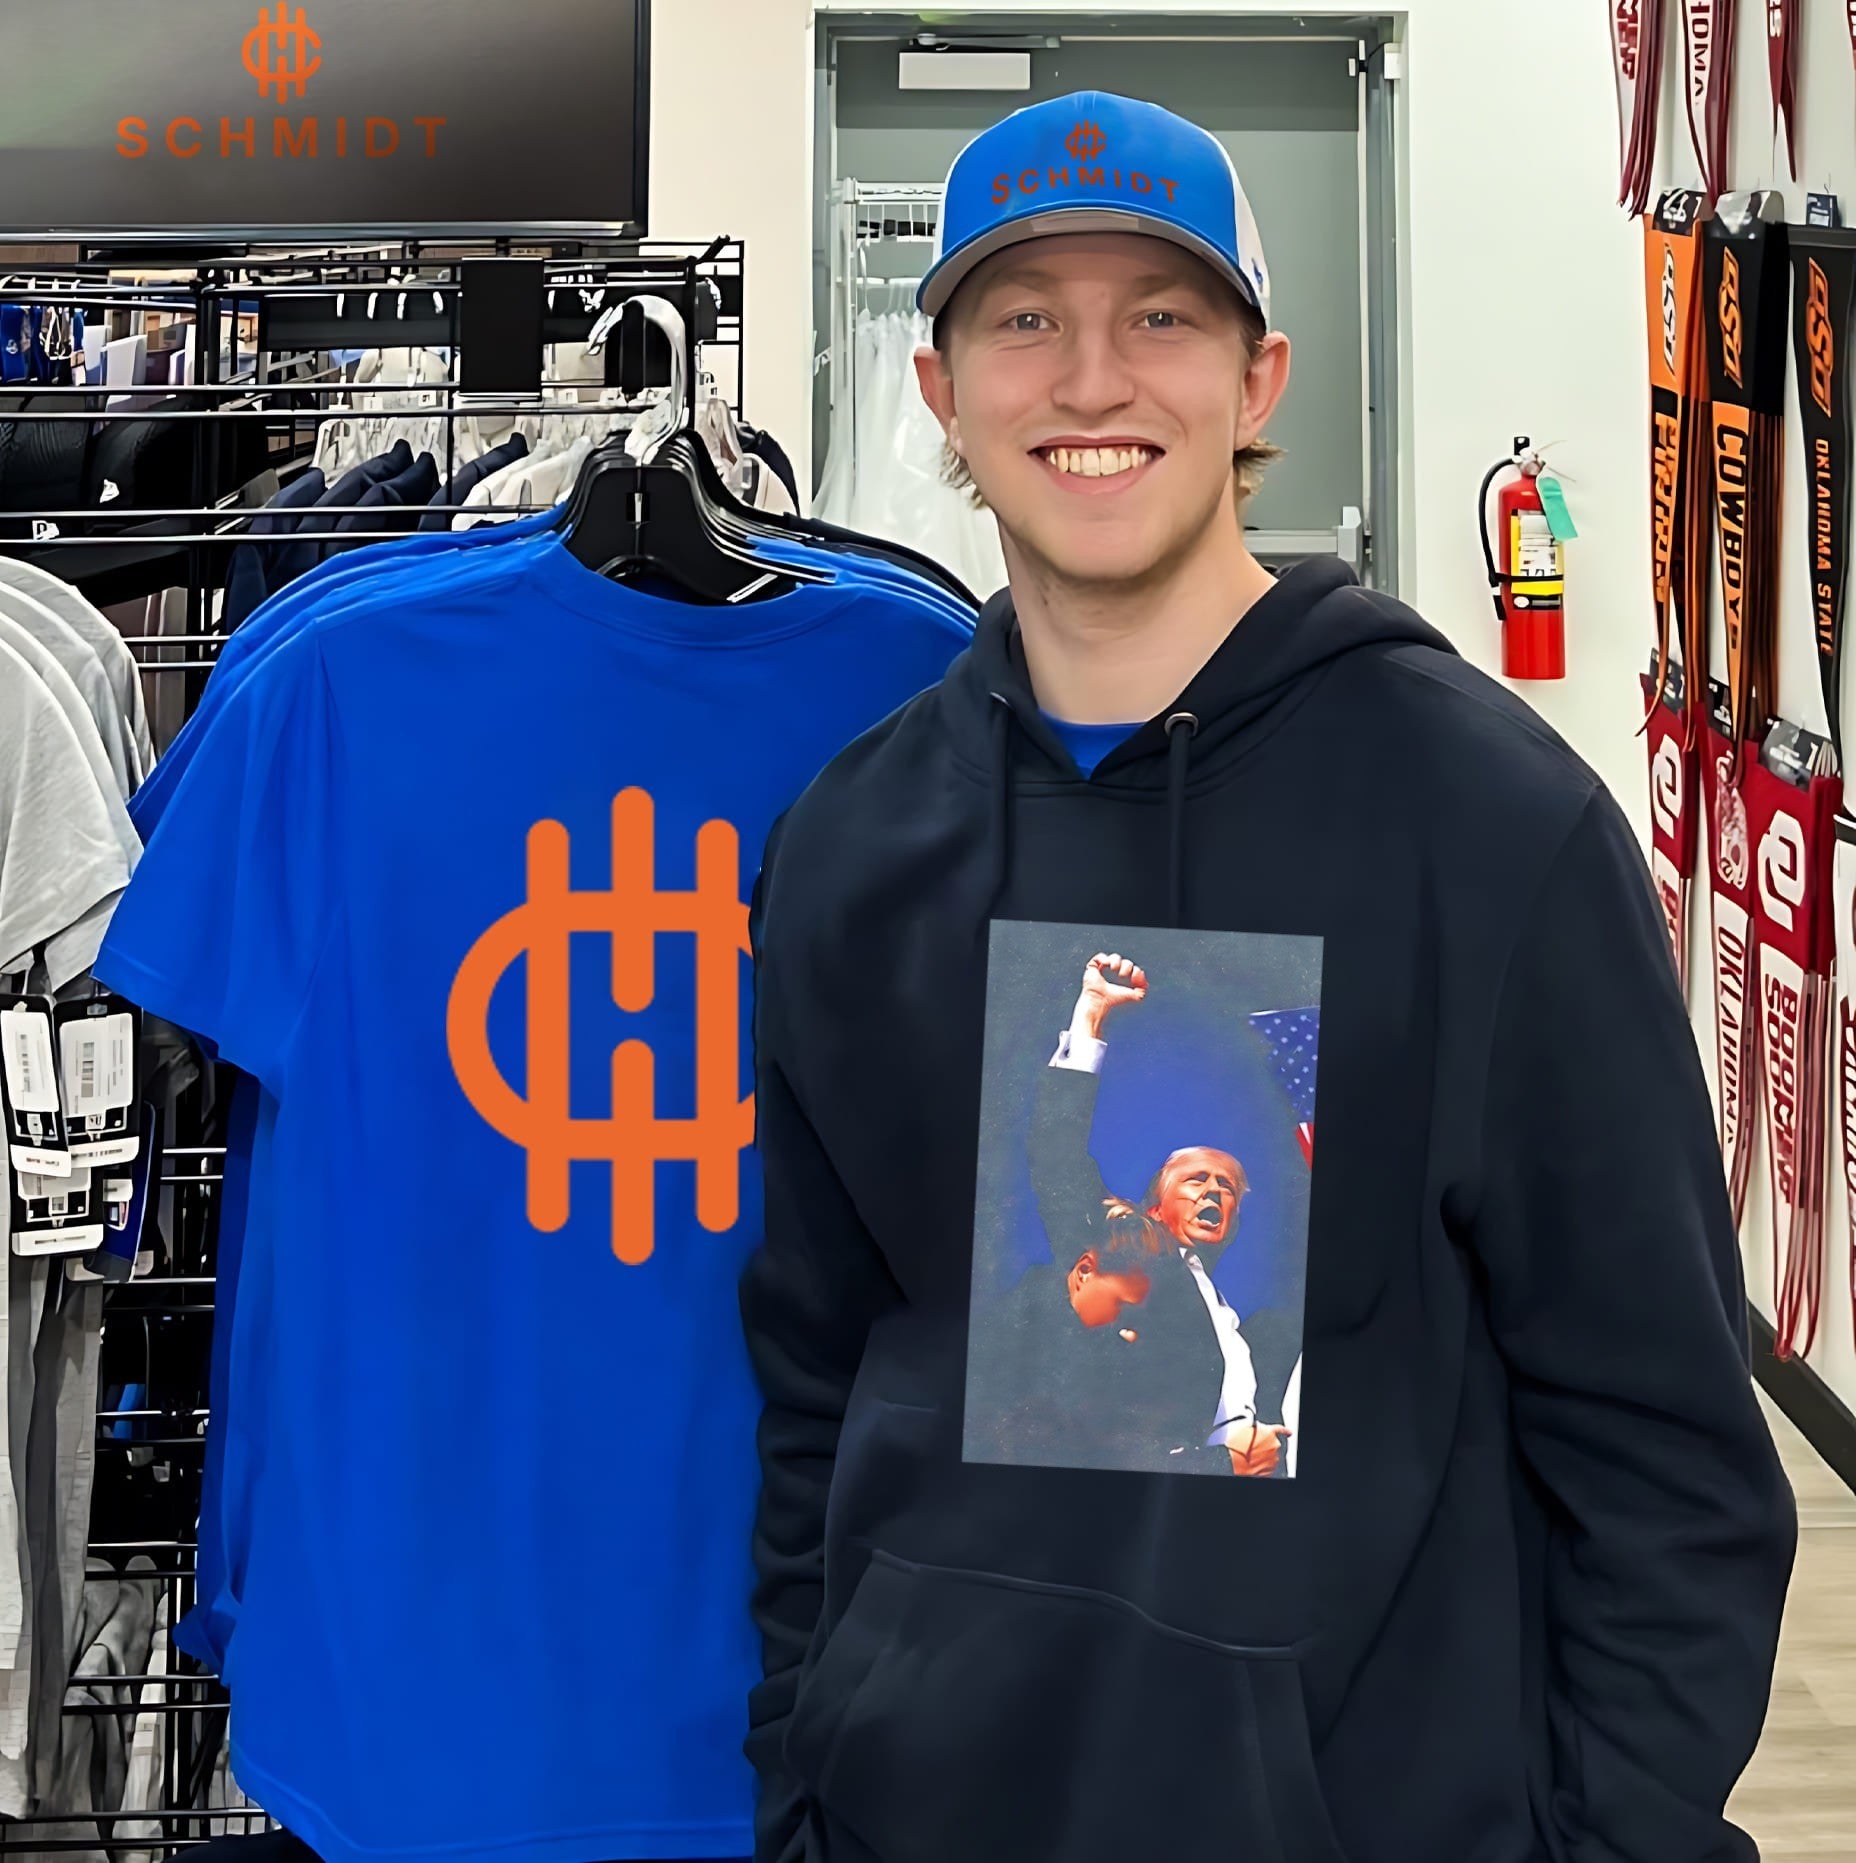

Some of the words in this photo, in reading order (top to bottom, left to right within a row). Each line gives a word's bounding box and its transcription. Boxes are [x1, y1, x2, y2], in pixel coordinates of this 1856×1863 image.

[115, 117, 448, 158] SCHMIDT
[991, 167, 1179, 205] SCHMIDT
[1805, 257, 1833, 419] OSU
[1757, 809, 1805, 933] OU
